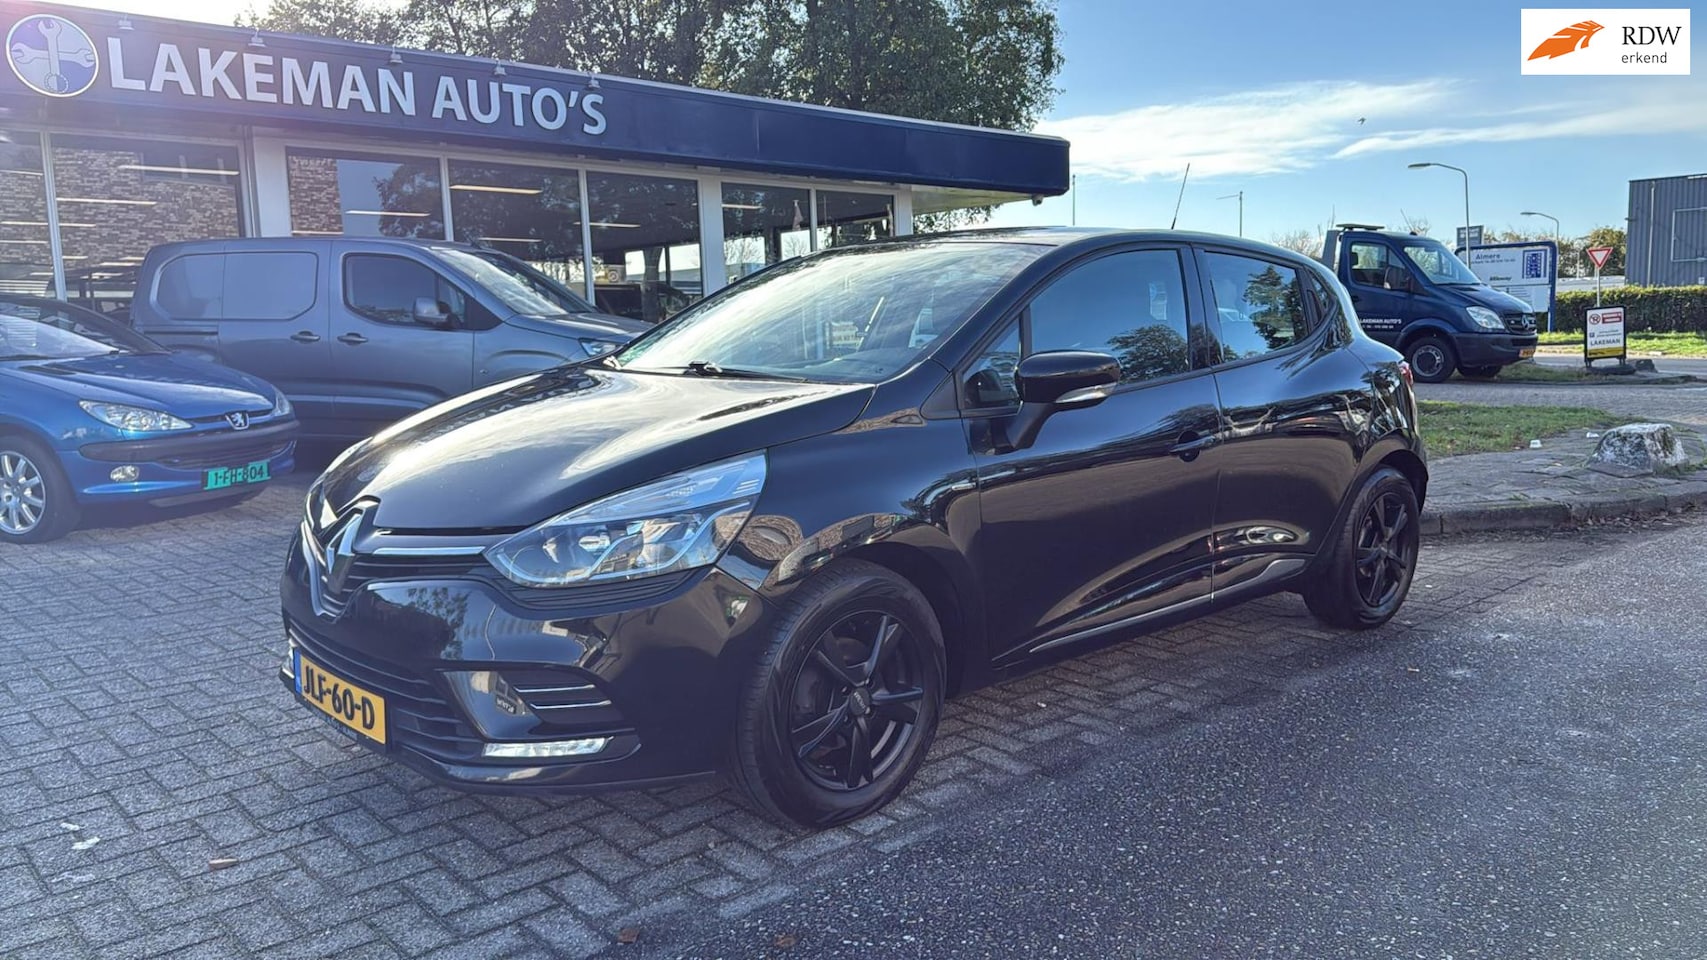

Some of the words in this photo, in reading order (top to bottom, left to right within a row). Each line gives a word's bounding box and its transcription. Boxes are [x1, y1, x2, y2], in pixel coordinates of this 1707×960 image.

[106, 35, 417, 117] LAKEMAN
[431, 75, 608, 136] AUTO'S
[1475, 253, 1501, 261] Almere
[1590, 338, 1621, 346] LAKEMAN
[214, 465, 264, 485] 1-FH-804
[304, 665, 376, 731] JLF-60-D
